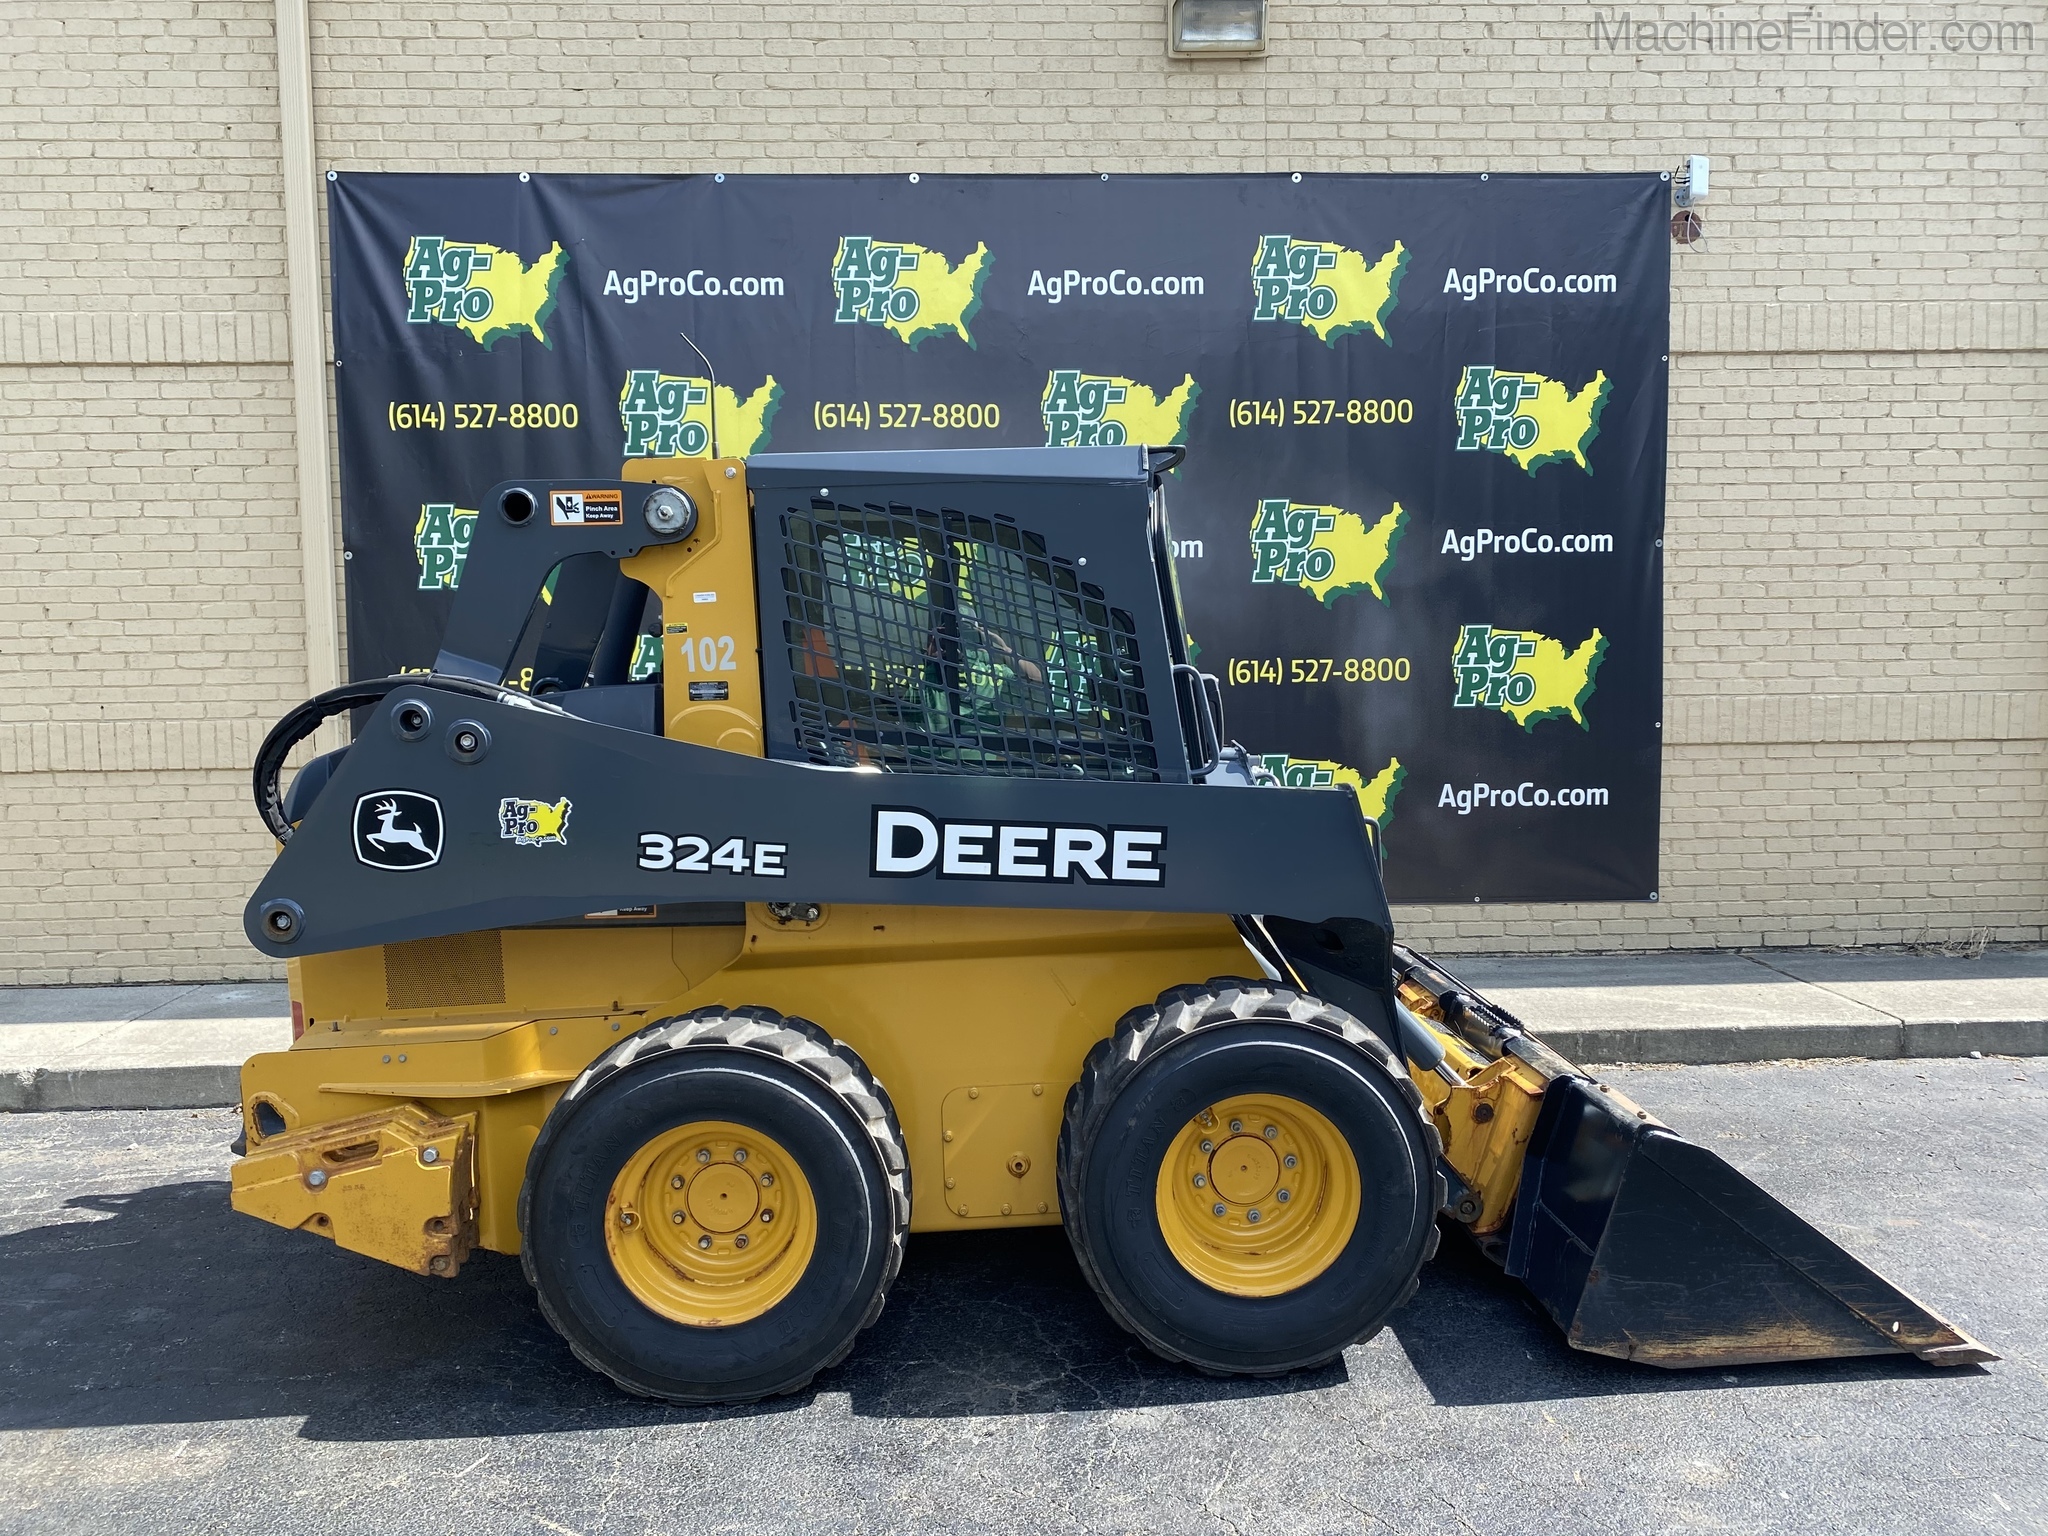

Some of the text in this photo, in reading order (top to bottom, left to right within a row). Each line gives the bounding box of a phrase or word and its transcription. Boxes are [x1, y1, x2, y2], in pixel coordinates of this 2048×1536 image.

[406, 236, 492, 289] Ag-
[834, 236, 917, 289] Ag-
[1253, 235, 1336, 287] Ag-
[407, 278, 493, 322] Pro
[602, 269, 784, 304] AgProCo.com
[835, 278, 919, 322] Pro
[1027, 269, 1204, 304] AgProCo.com
[1253, 276, 1336, 320] Pro
[1442, 267, 1617, 301] AgProCo.com
[622, 370, 706, 423] Ag-
[1043, 370, 1126, 423] Ag-
[1229, 399, 1413, 427] (614) 527-8800
[1457, 366, 1538, 417] Ag-
[388, 403, 578, 430] (614) 527-8800
[624, 411, 708, 456] Pro
[814, 403, 999, 429] (614) 527-8800
[1045, 410, 1126, 447] Pro
[1457, 406, 1538, 450] Pro
[417, 504, 478, 555] Ag
[1252, 499, 1334, 551] Ag-
[1440, 527, 1613, 562] AgProCo.com
[1252, 540, 1334, 583] Pro
[680, 635, 737, 673] 102
[1454, 624, 1535, 675] Ag-
[1228, 658, 1411, 686] (614) 527-8800
[1454, 664, 1535, 707] Pro
[502, 800, 538, 821] Ag-
[1437, 782, 1609, 815] AgProCo.com
[503, 818, 539, 836] Pro
[876, 810, 1163, 882] DEERE
[639, 834, 787, 876] 324E
[573, 1132, 623, 1213] TITAN
[1126, 1116, 1168, 1198] TITAN
